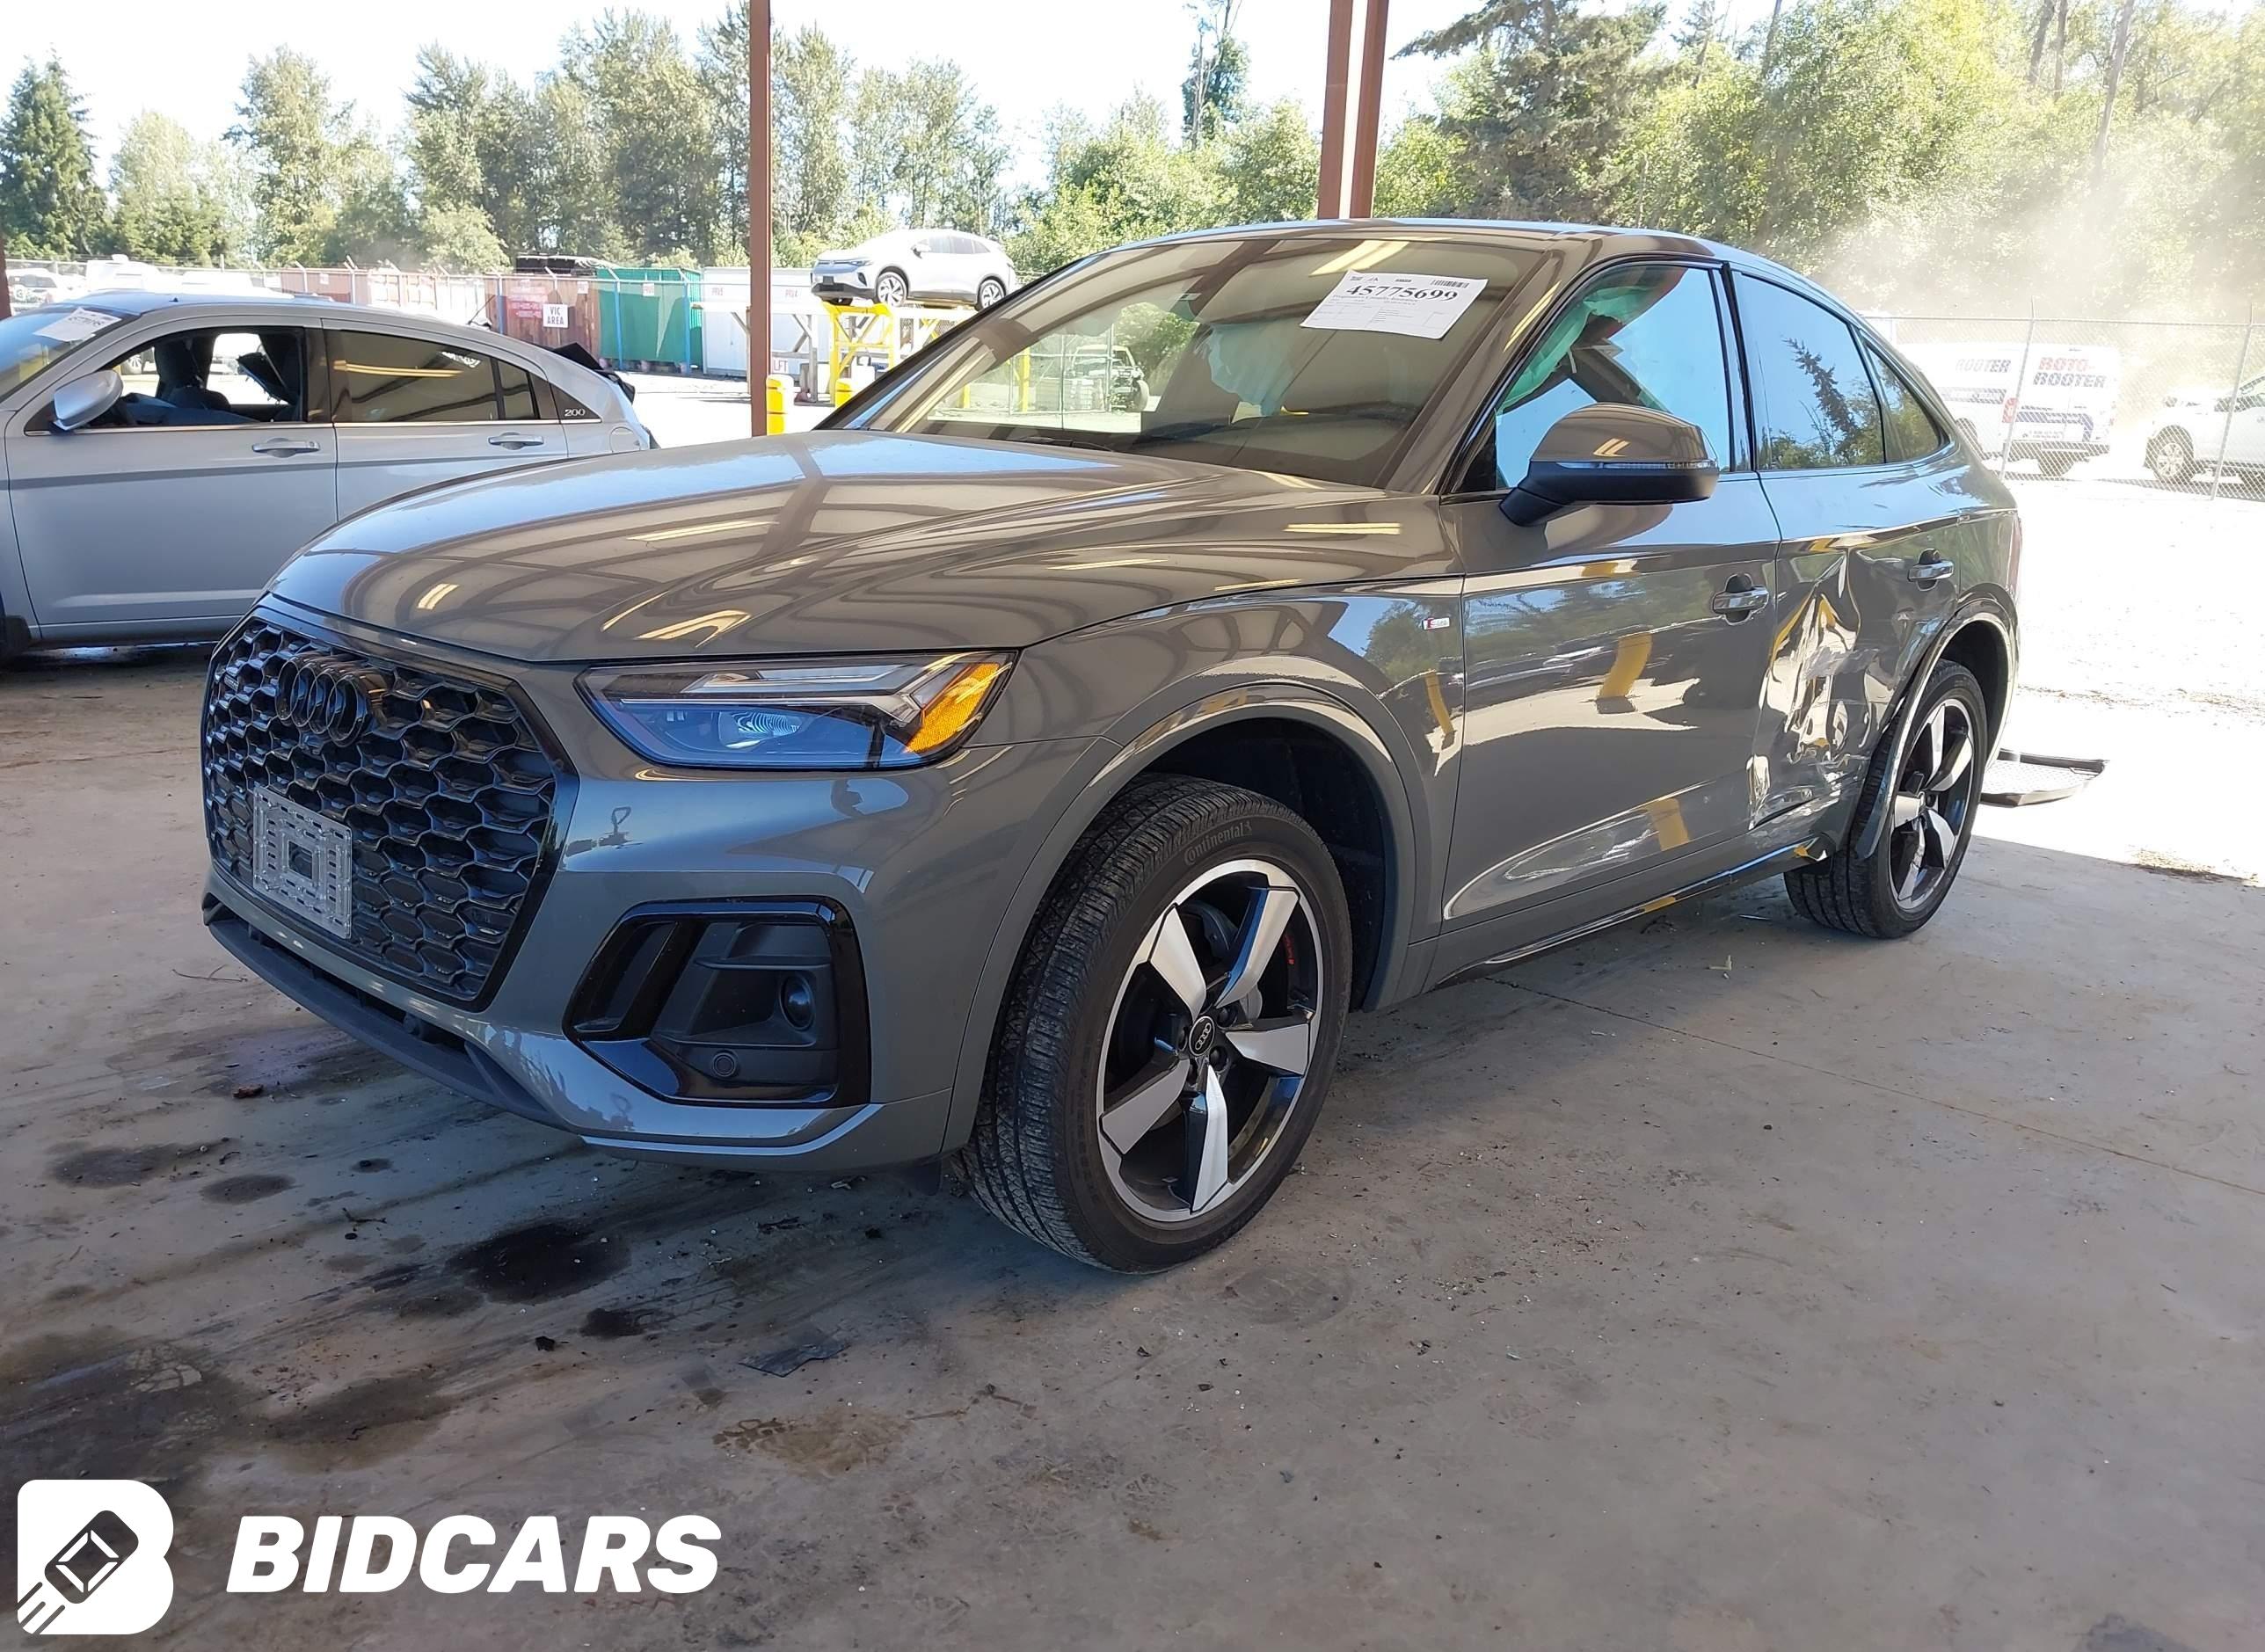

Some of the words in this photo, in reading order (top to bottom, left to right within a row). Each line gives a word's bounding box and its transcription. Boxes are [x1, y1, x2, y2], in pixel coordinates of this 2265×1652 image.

[1346, 285, 1459, 302] 45775699
[550, 306, 561, 316] VIC
[547, 316, 564, 324] AREA
[1955, 359, 2012, 373] ROOTER
[2033, 372, 2107, 388] ROOTER
[564, 408, 586, 417] 200
[1183, 822, 1244, 865] Continental
